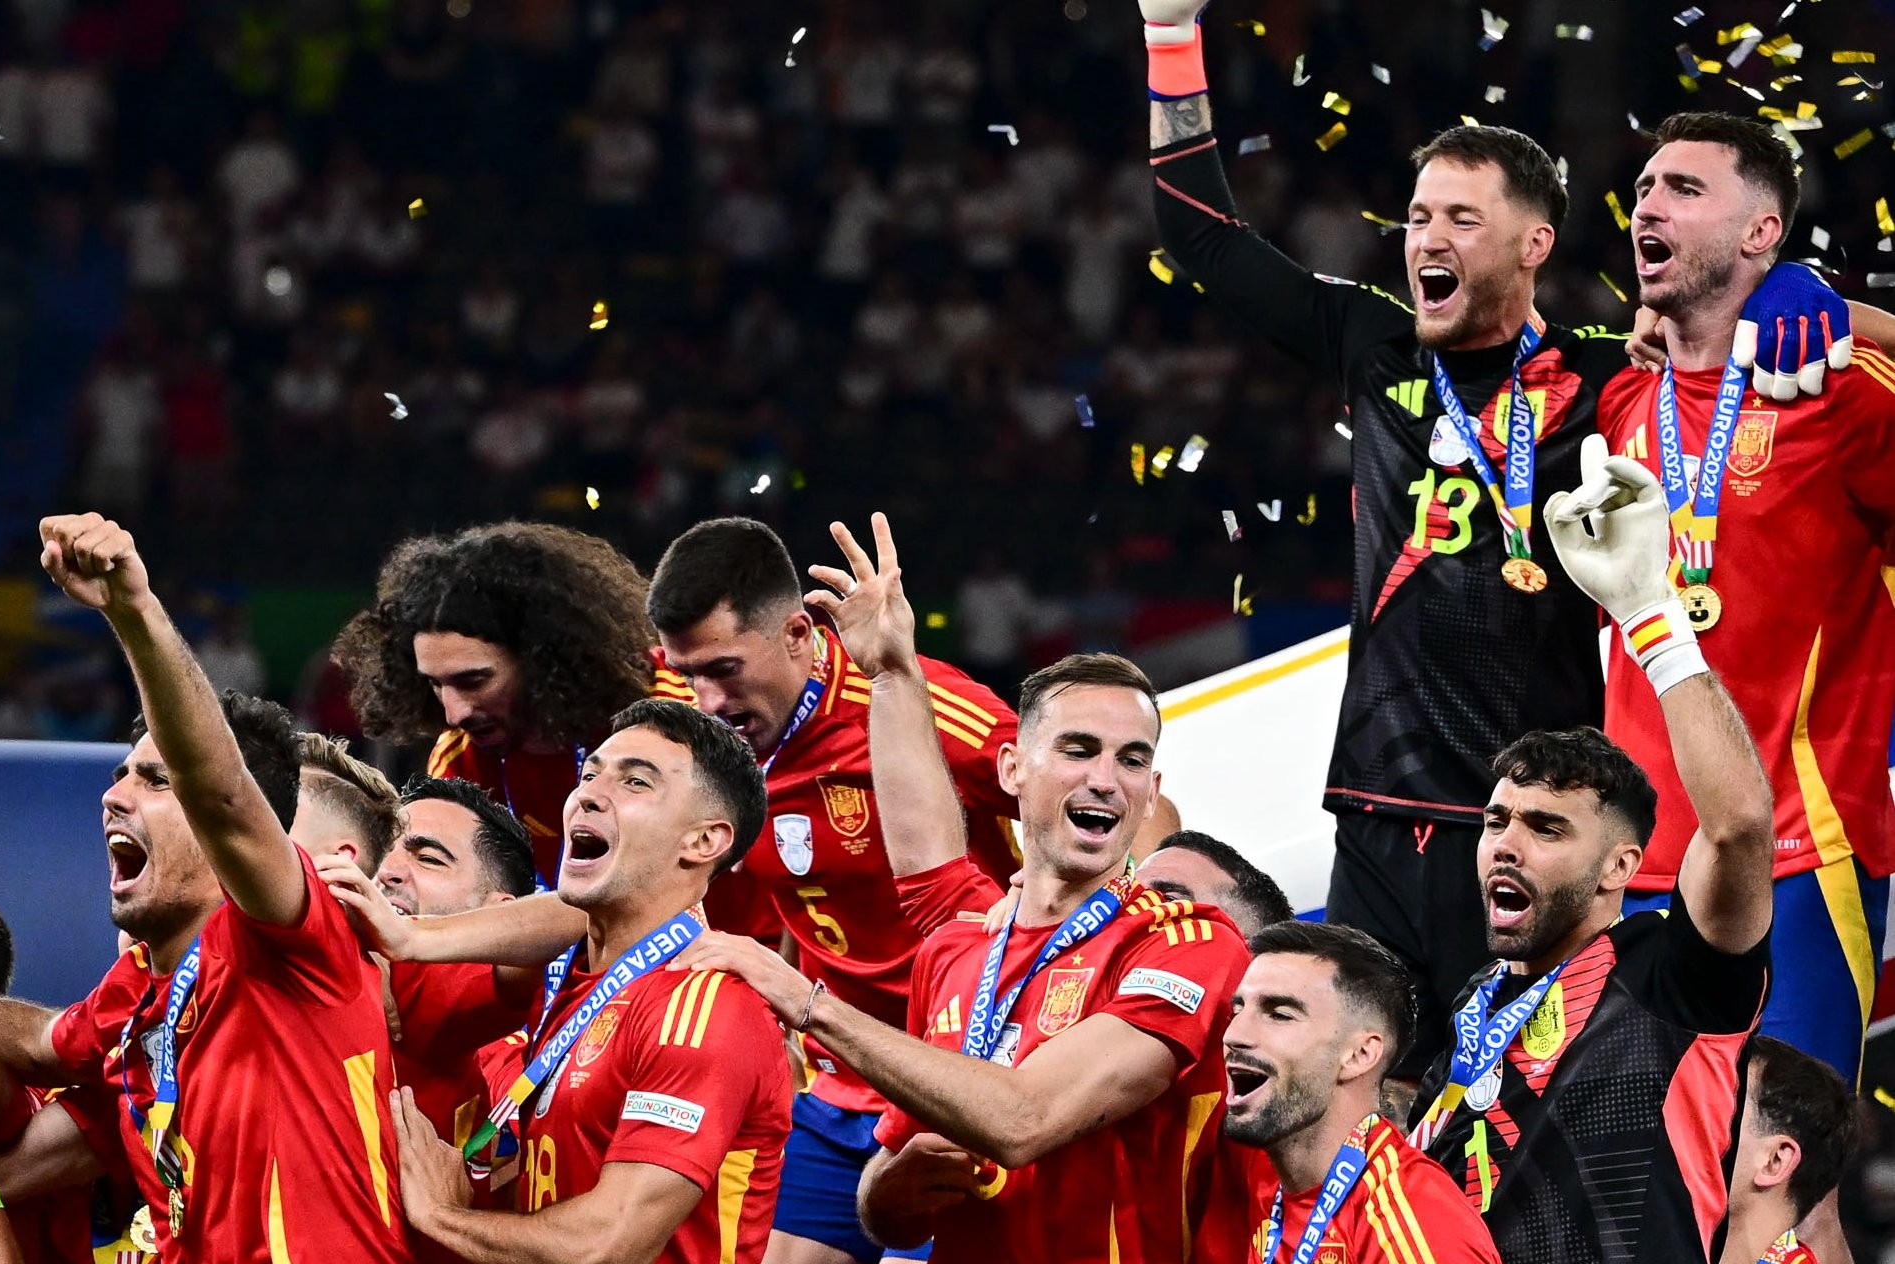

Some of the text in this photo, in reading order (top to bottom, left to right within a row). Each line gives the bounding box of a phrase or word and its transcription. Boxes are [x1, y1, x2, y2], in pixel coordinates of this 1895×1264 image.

[1700, 365, 1743, 499] AEURO2024
[1408, 468, 1480, 555] 13
[797, 887, 848, 956] 5
[626, 1100, 700, 1123] FOUNDATION
[1465, 1119, 1492, 1213] 1
